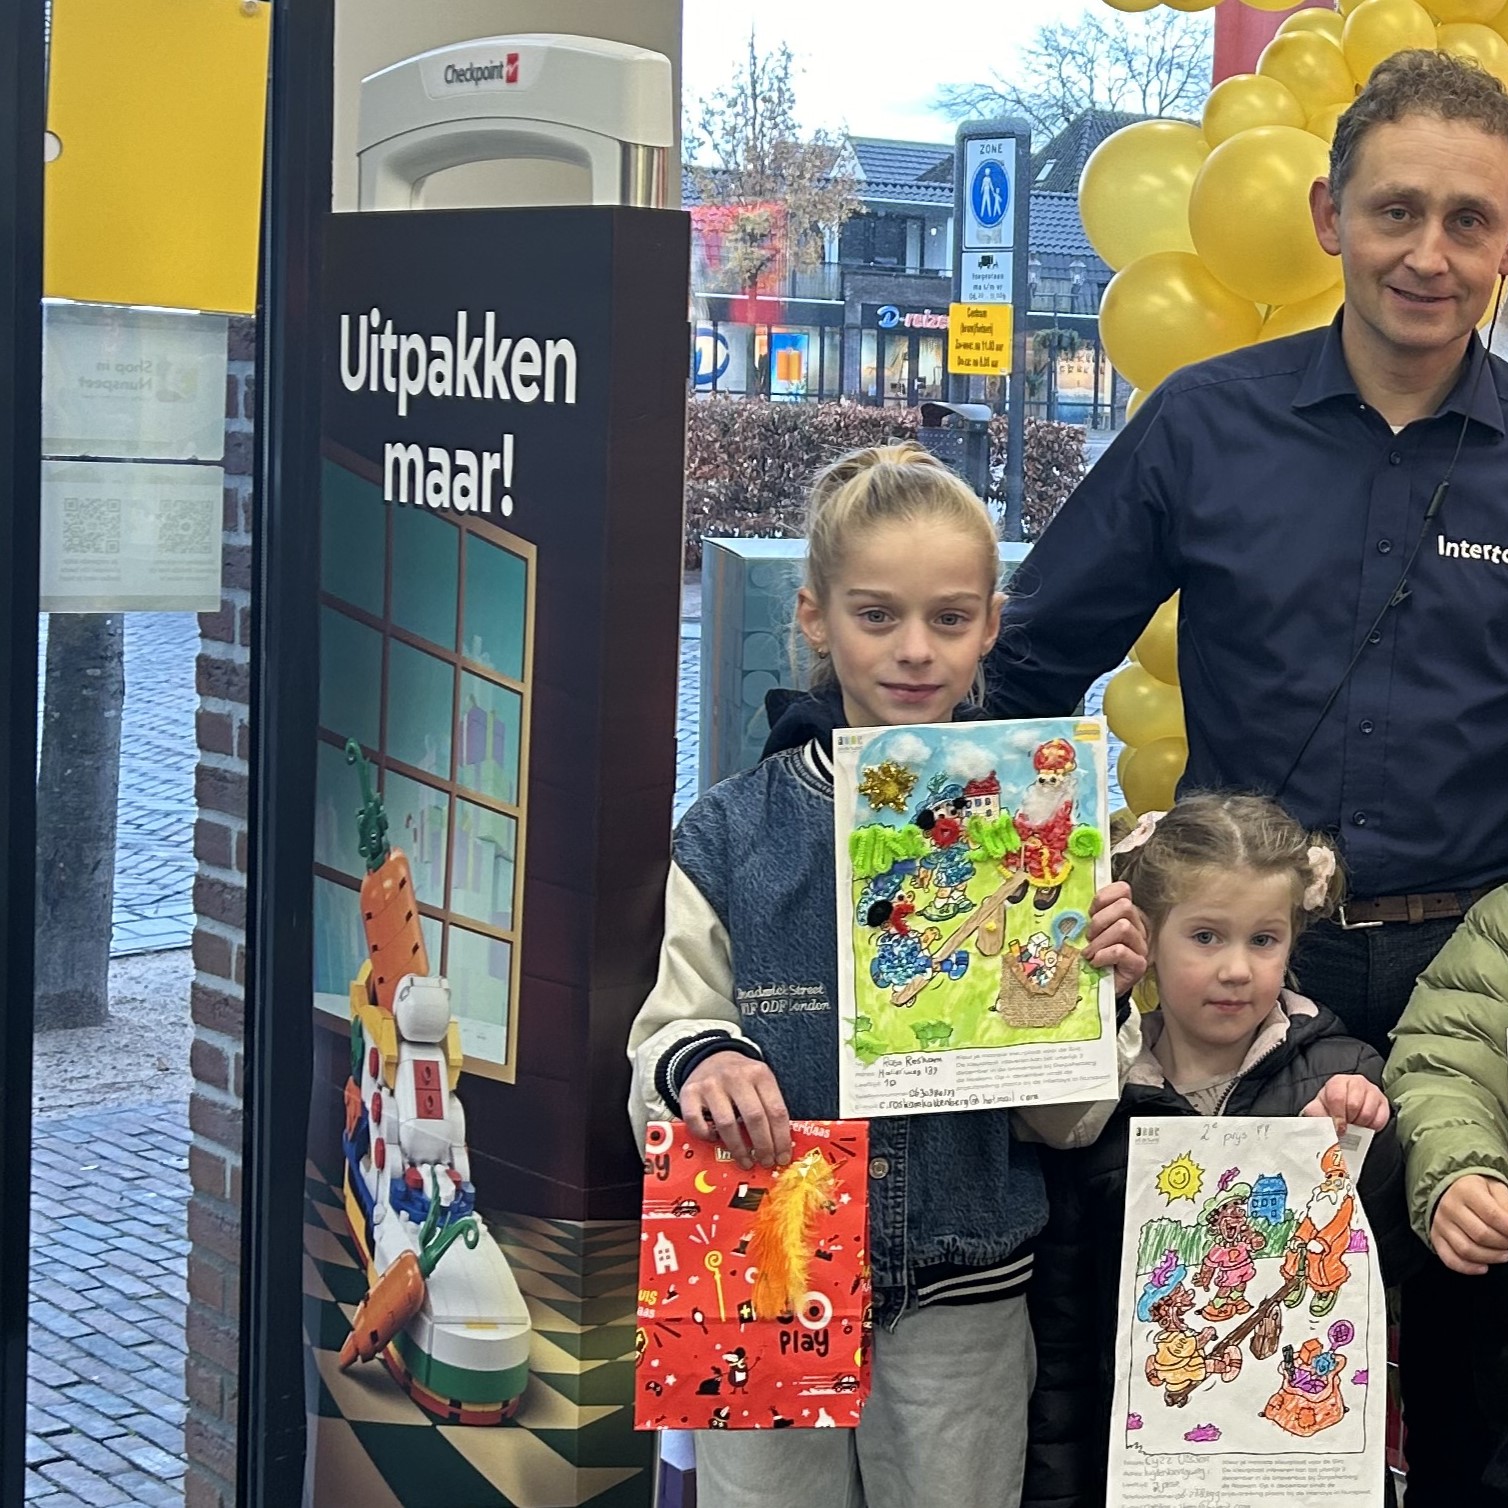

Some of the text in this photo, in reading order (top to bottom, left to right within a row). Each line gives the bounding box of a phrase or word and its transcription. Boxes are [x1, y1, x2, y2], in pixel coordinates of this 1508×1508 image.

[444, 62, 504, 86] Checkpoint
[979, 143, 1003, 155] ZONE
[876, 304, 950, 329] D-reize
[339, 307, 578, 417] Uitpakken
[383, 434, 514, 518] maar!
[788, 984, 825, 996] Street
[789, 998, 831, 1012] London
[779, 1328, 830, 1357] Play
